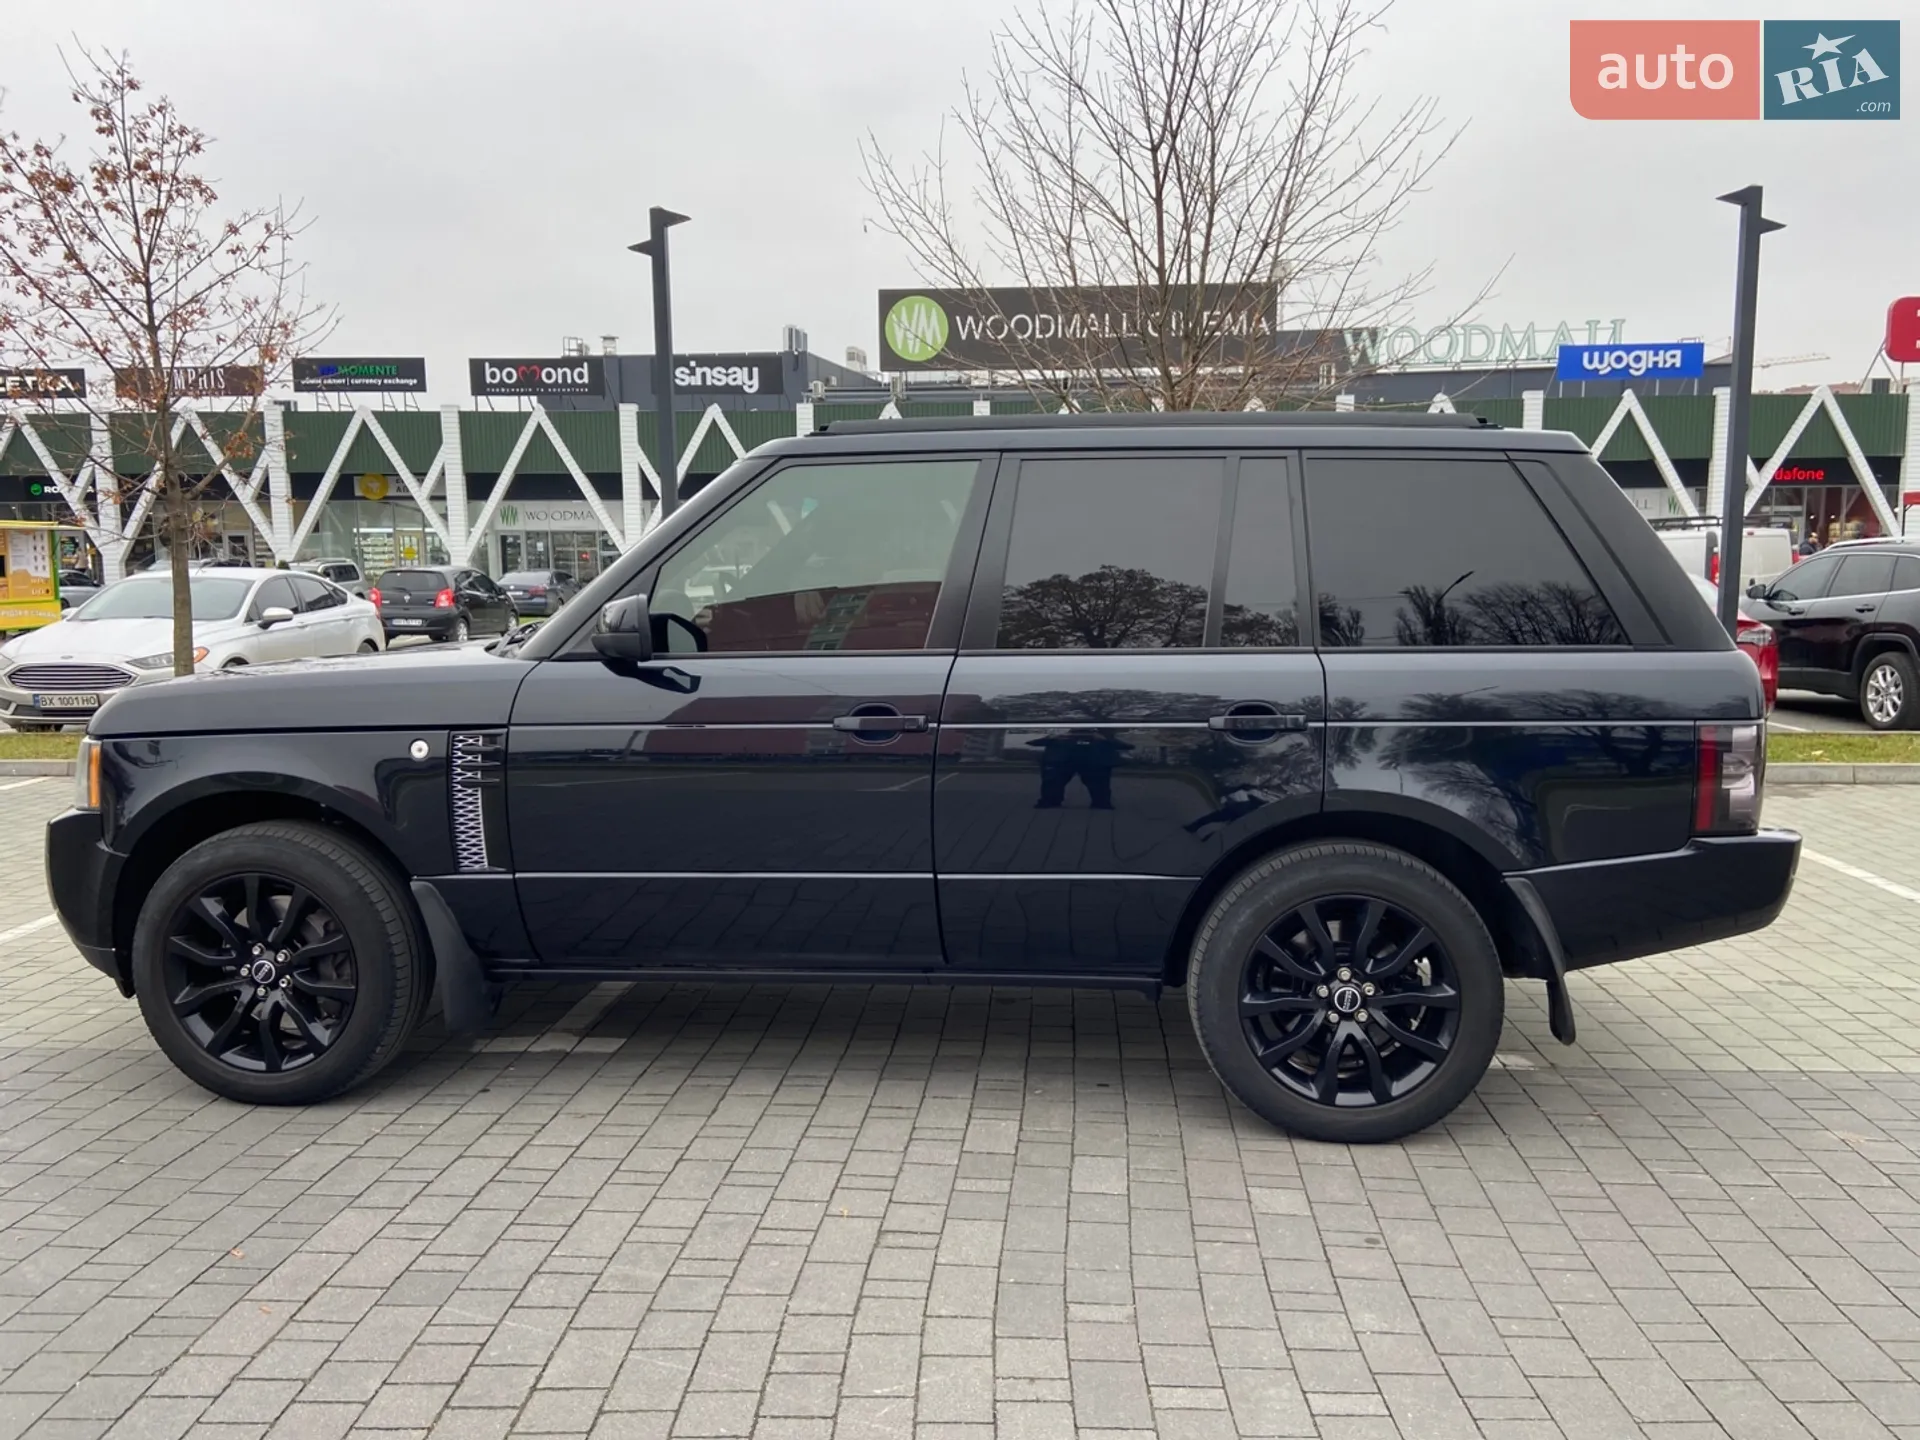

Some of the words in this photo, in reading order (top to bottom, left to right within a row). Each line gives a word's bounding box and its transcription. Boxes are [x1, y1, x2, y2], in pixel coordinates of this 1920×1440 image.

[955, 313, 1137, 341] WOODMALL
[1582, 348, 1682, 377] щодня
[0, 375, 75, 392] ETKA
[350, 378, 381, 387] currency
[383, 377, 418, 387] exchange
[674, 360, 760, 394] sinsay
[1774, 466, 1825, 480] dafone
[525, 510, 595, 521] WOODMA
[58, 696, 79, 706] 1001
